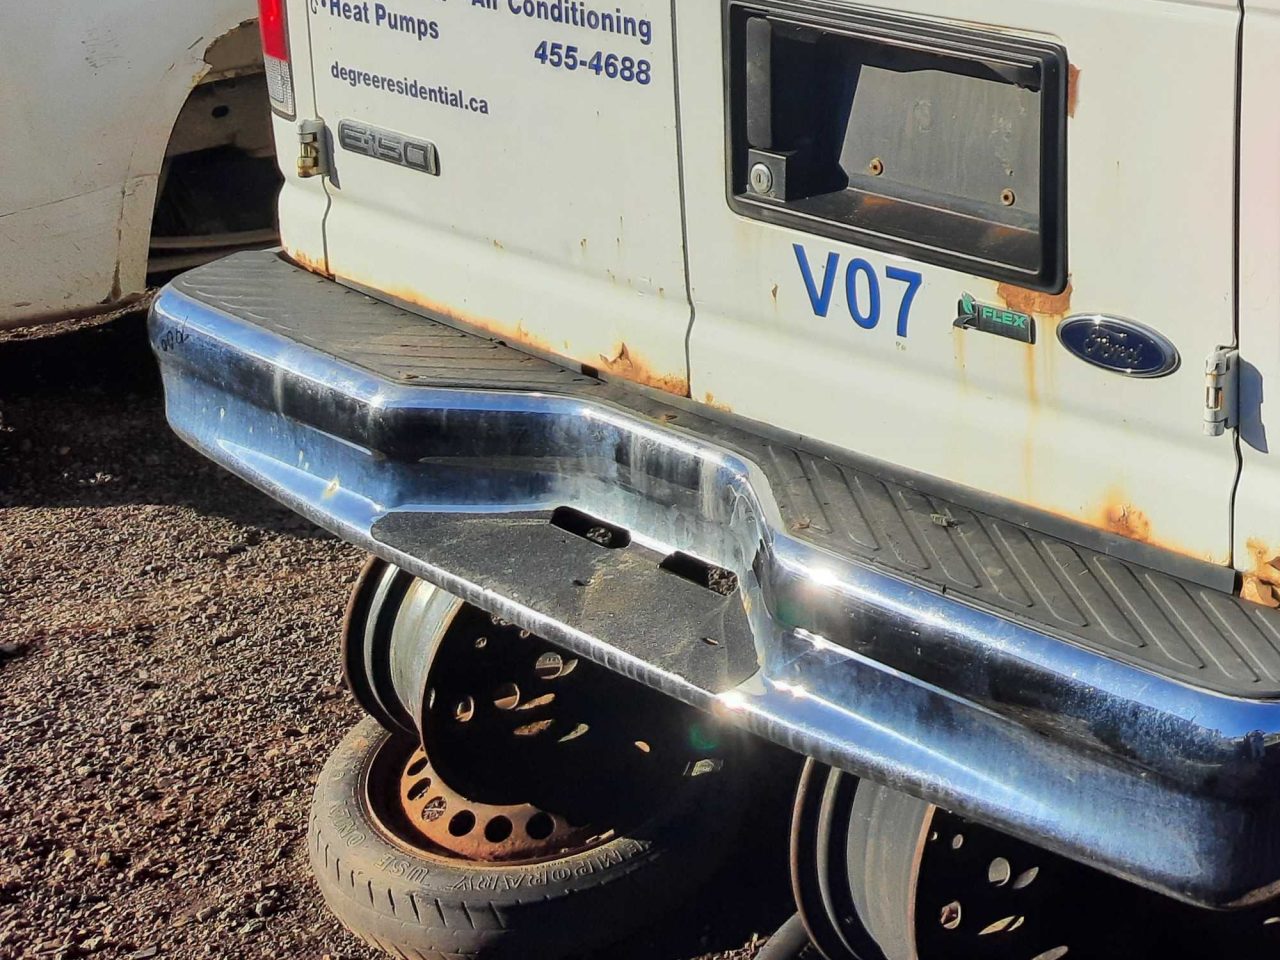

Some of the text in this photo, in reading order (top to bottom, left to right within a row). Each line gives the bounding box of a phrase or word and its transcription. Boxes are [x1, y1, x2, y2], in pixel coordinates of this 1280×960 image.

[374, 3, 440, 41] Pumps
[534, 40, 652, 85] 455-4688
[330, 60, 490, 115] degreeresidential.ca
[792, 242, 923, 339] V07
[981, 306, 1028, 329] FLEX
